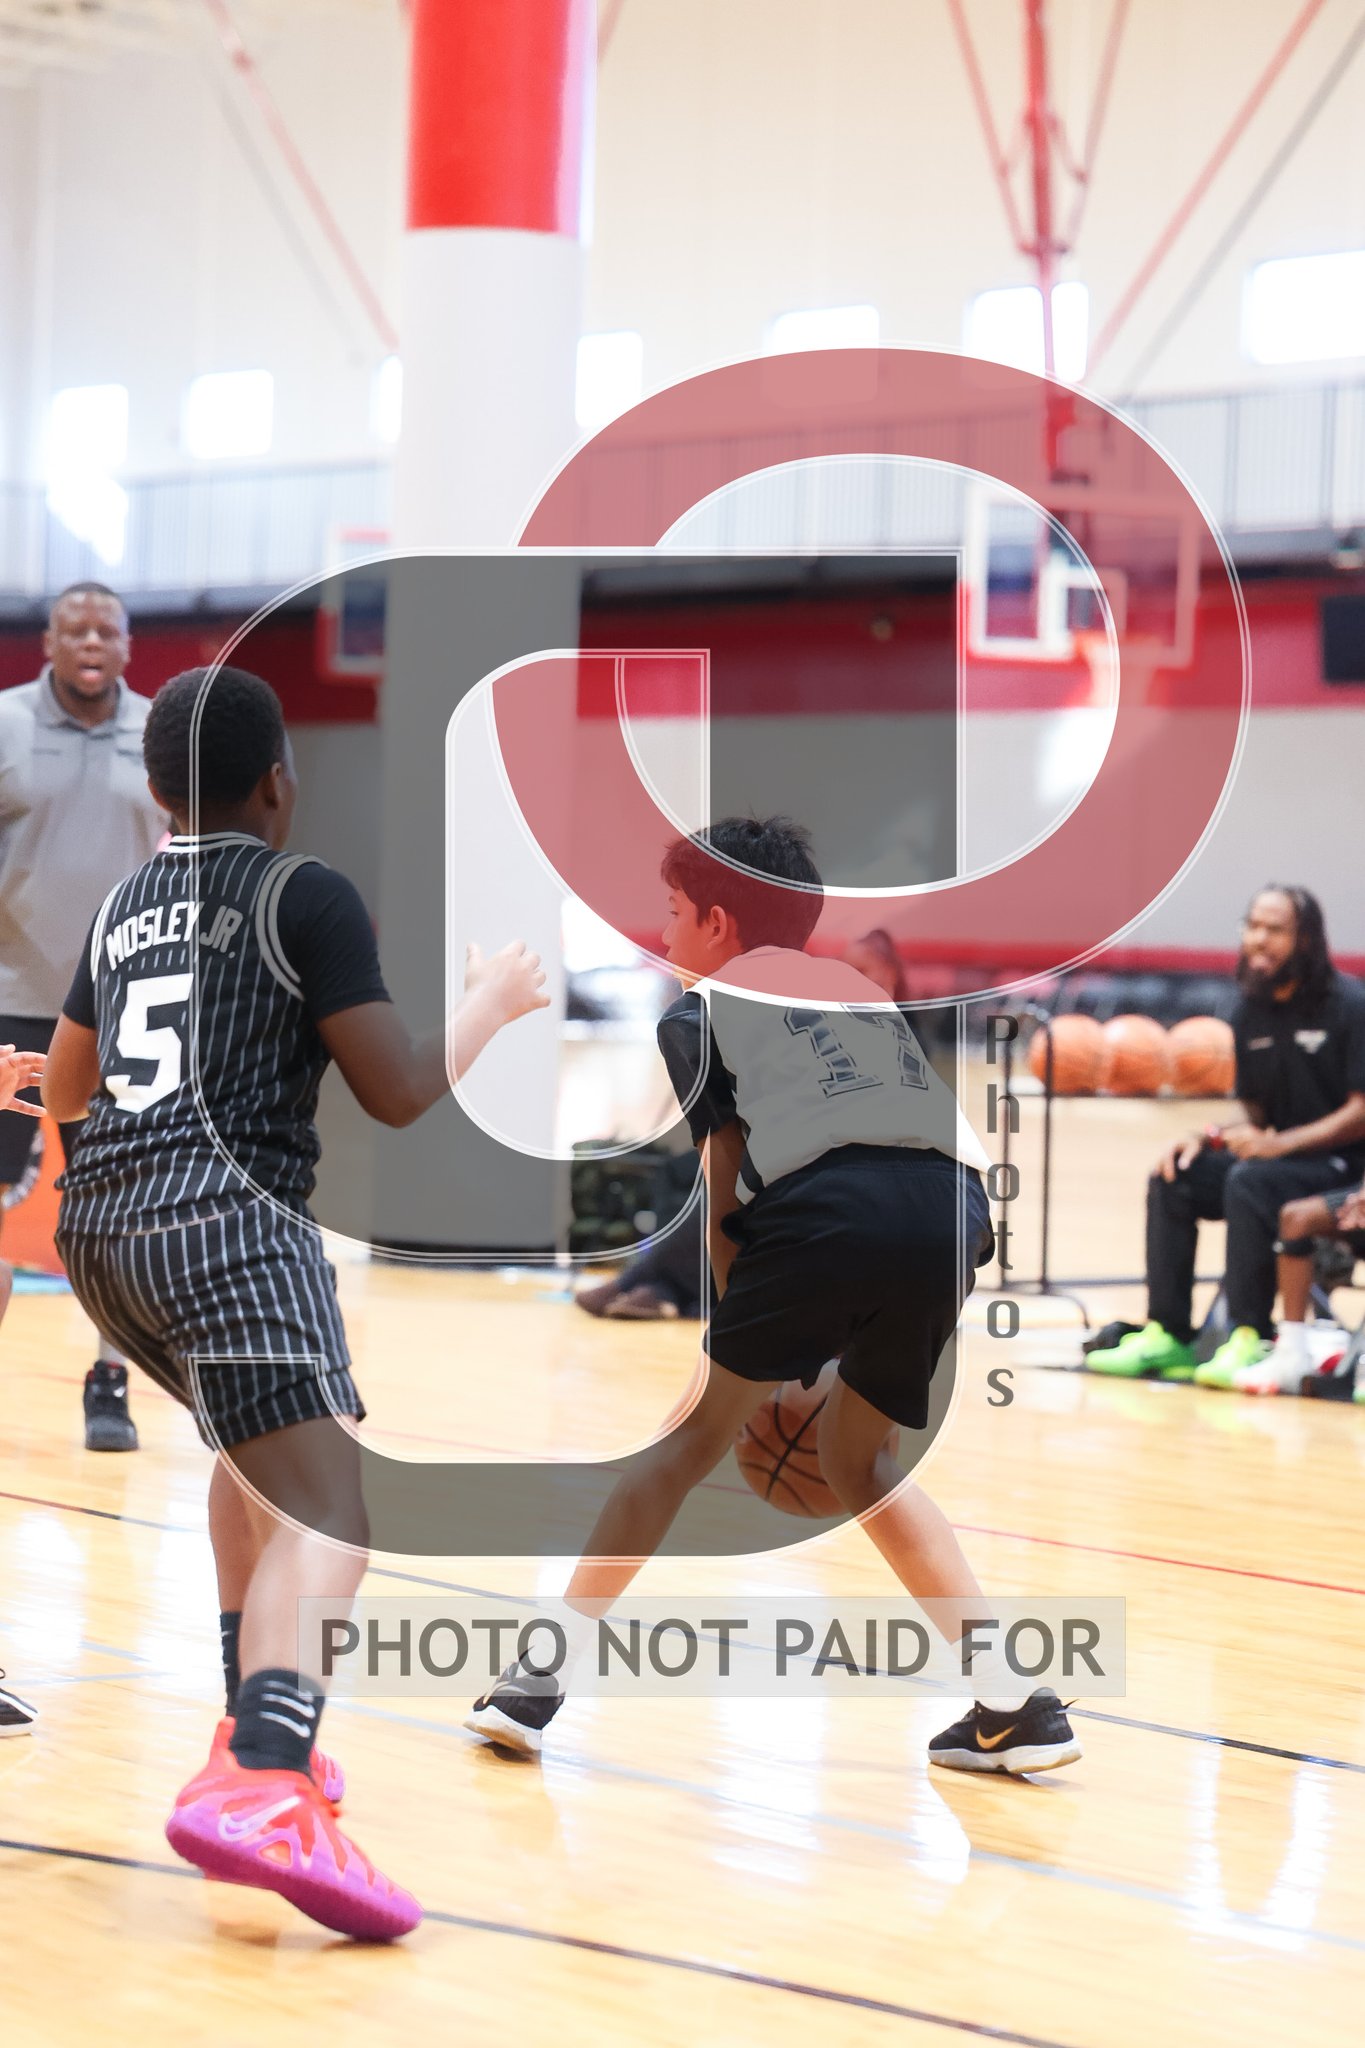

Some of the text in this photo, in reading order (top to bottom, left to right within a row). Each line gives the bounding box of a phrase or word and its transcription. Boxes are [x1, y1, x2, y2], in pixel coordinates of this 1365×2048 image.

[106, 901, 243, 971] MOSLEY JR.
[105, 973, 194, 1114] 5
[784, 1002, 929, 1098] 17
